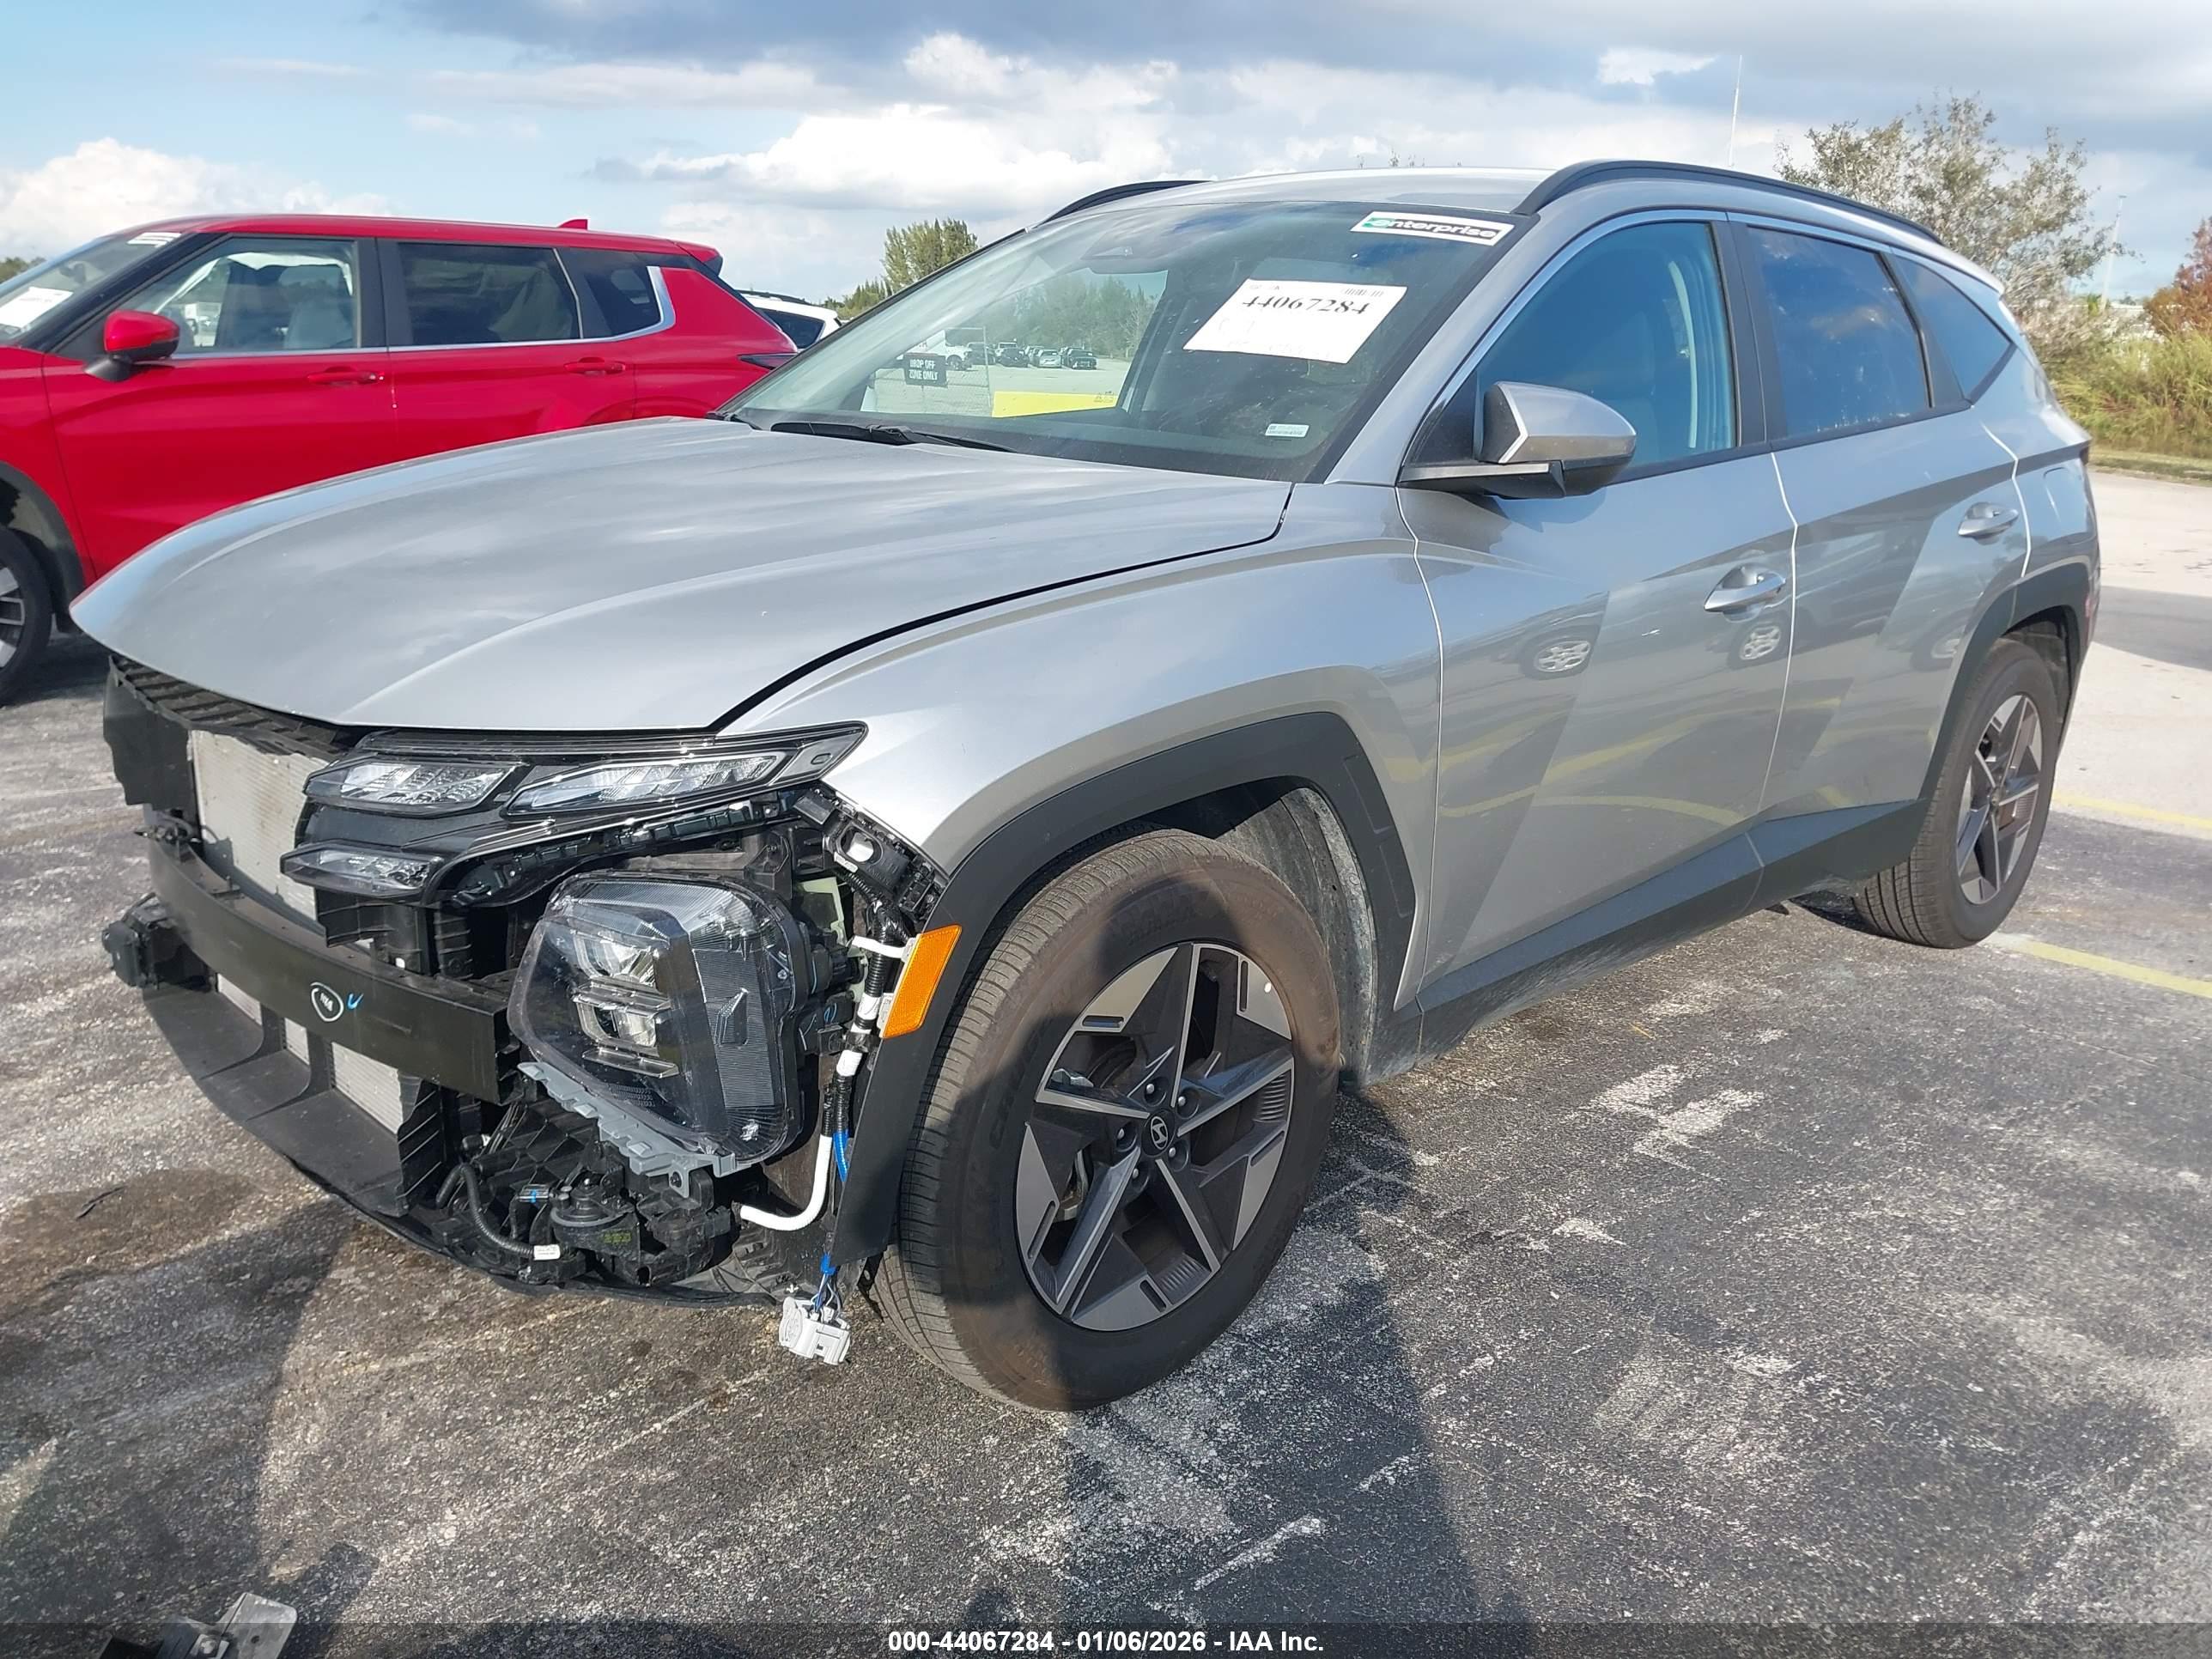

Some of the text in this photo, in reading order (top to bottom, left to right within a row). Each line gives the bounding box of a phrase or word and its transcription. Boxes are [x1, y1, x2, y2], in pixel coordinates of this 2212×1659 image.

[1368, 217, 1497, 238] enterprise
[1243, 295, 1370, 314] 44067284
[924, 359, 936, 370] OFF
[922, 370, 938, 380] ONLY
